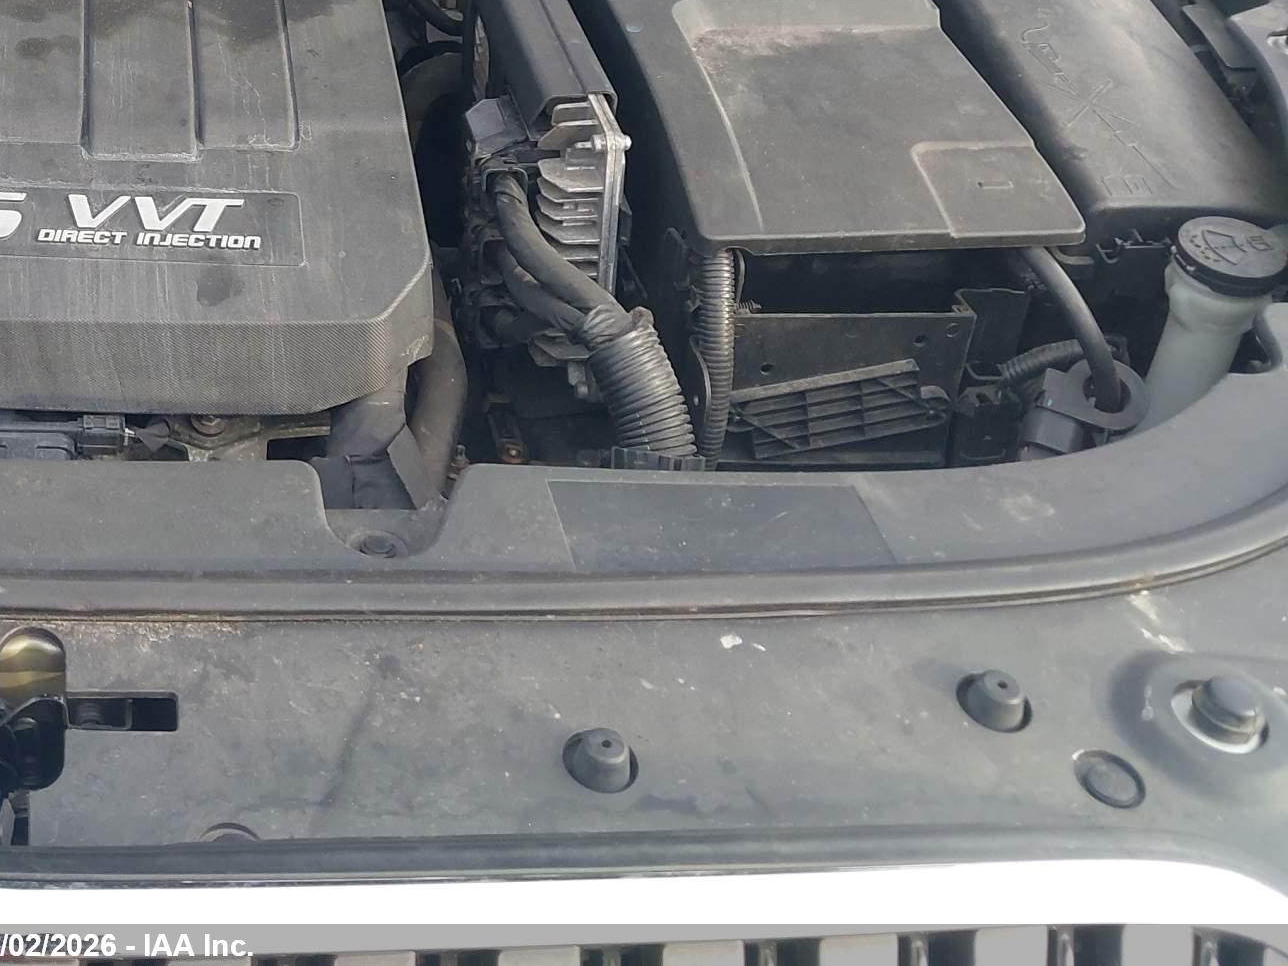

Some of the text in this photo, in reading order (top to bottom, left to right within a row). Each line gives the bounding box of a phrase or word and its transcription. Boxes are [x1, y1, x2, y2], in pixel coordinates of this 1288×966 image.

[68, 193, 245, 233] VVT
[38, 229, 261, 249] DIRECT INJECTION
